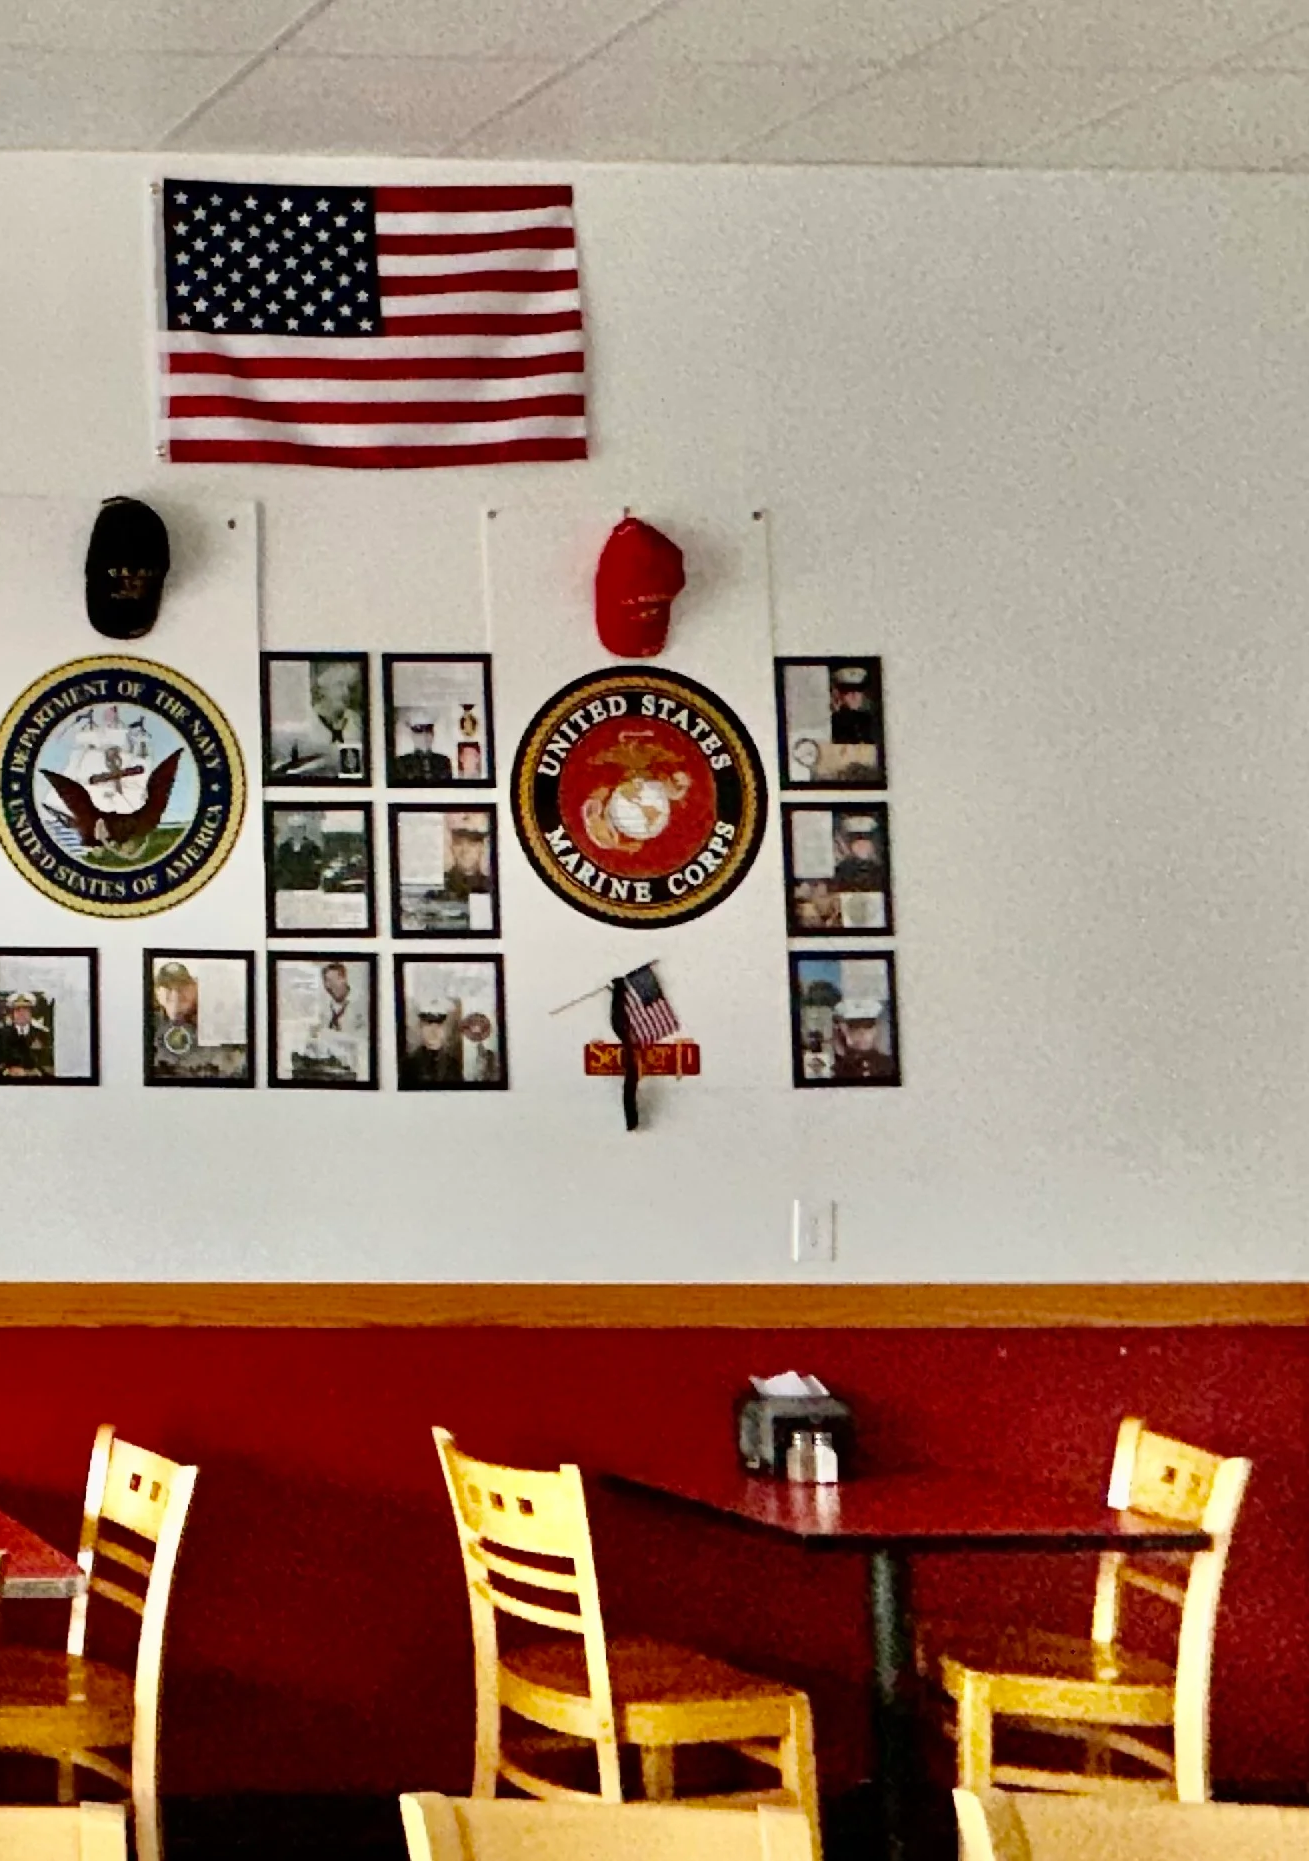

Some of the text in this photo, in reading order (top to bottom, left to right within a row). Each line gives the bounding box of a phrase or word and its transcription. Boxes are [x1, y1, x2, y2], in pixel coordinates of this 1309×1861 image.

[10, 680, 222, 774] DEPARTMENT OF THE NAVY
[537, 695, 628, 777] UNITED
[641, 694, 732, 771] STATES
[7, 799, 57, 871] UNITED
[53, 863, 127, 899] STATES
[132, 873, 159, 895] OF
[165, 804, 224, 883] AMERICA
[544, 824, 653, 903] MARINE
[667, 821, 736, 896] CORPS
